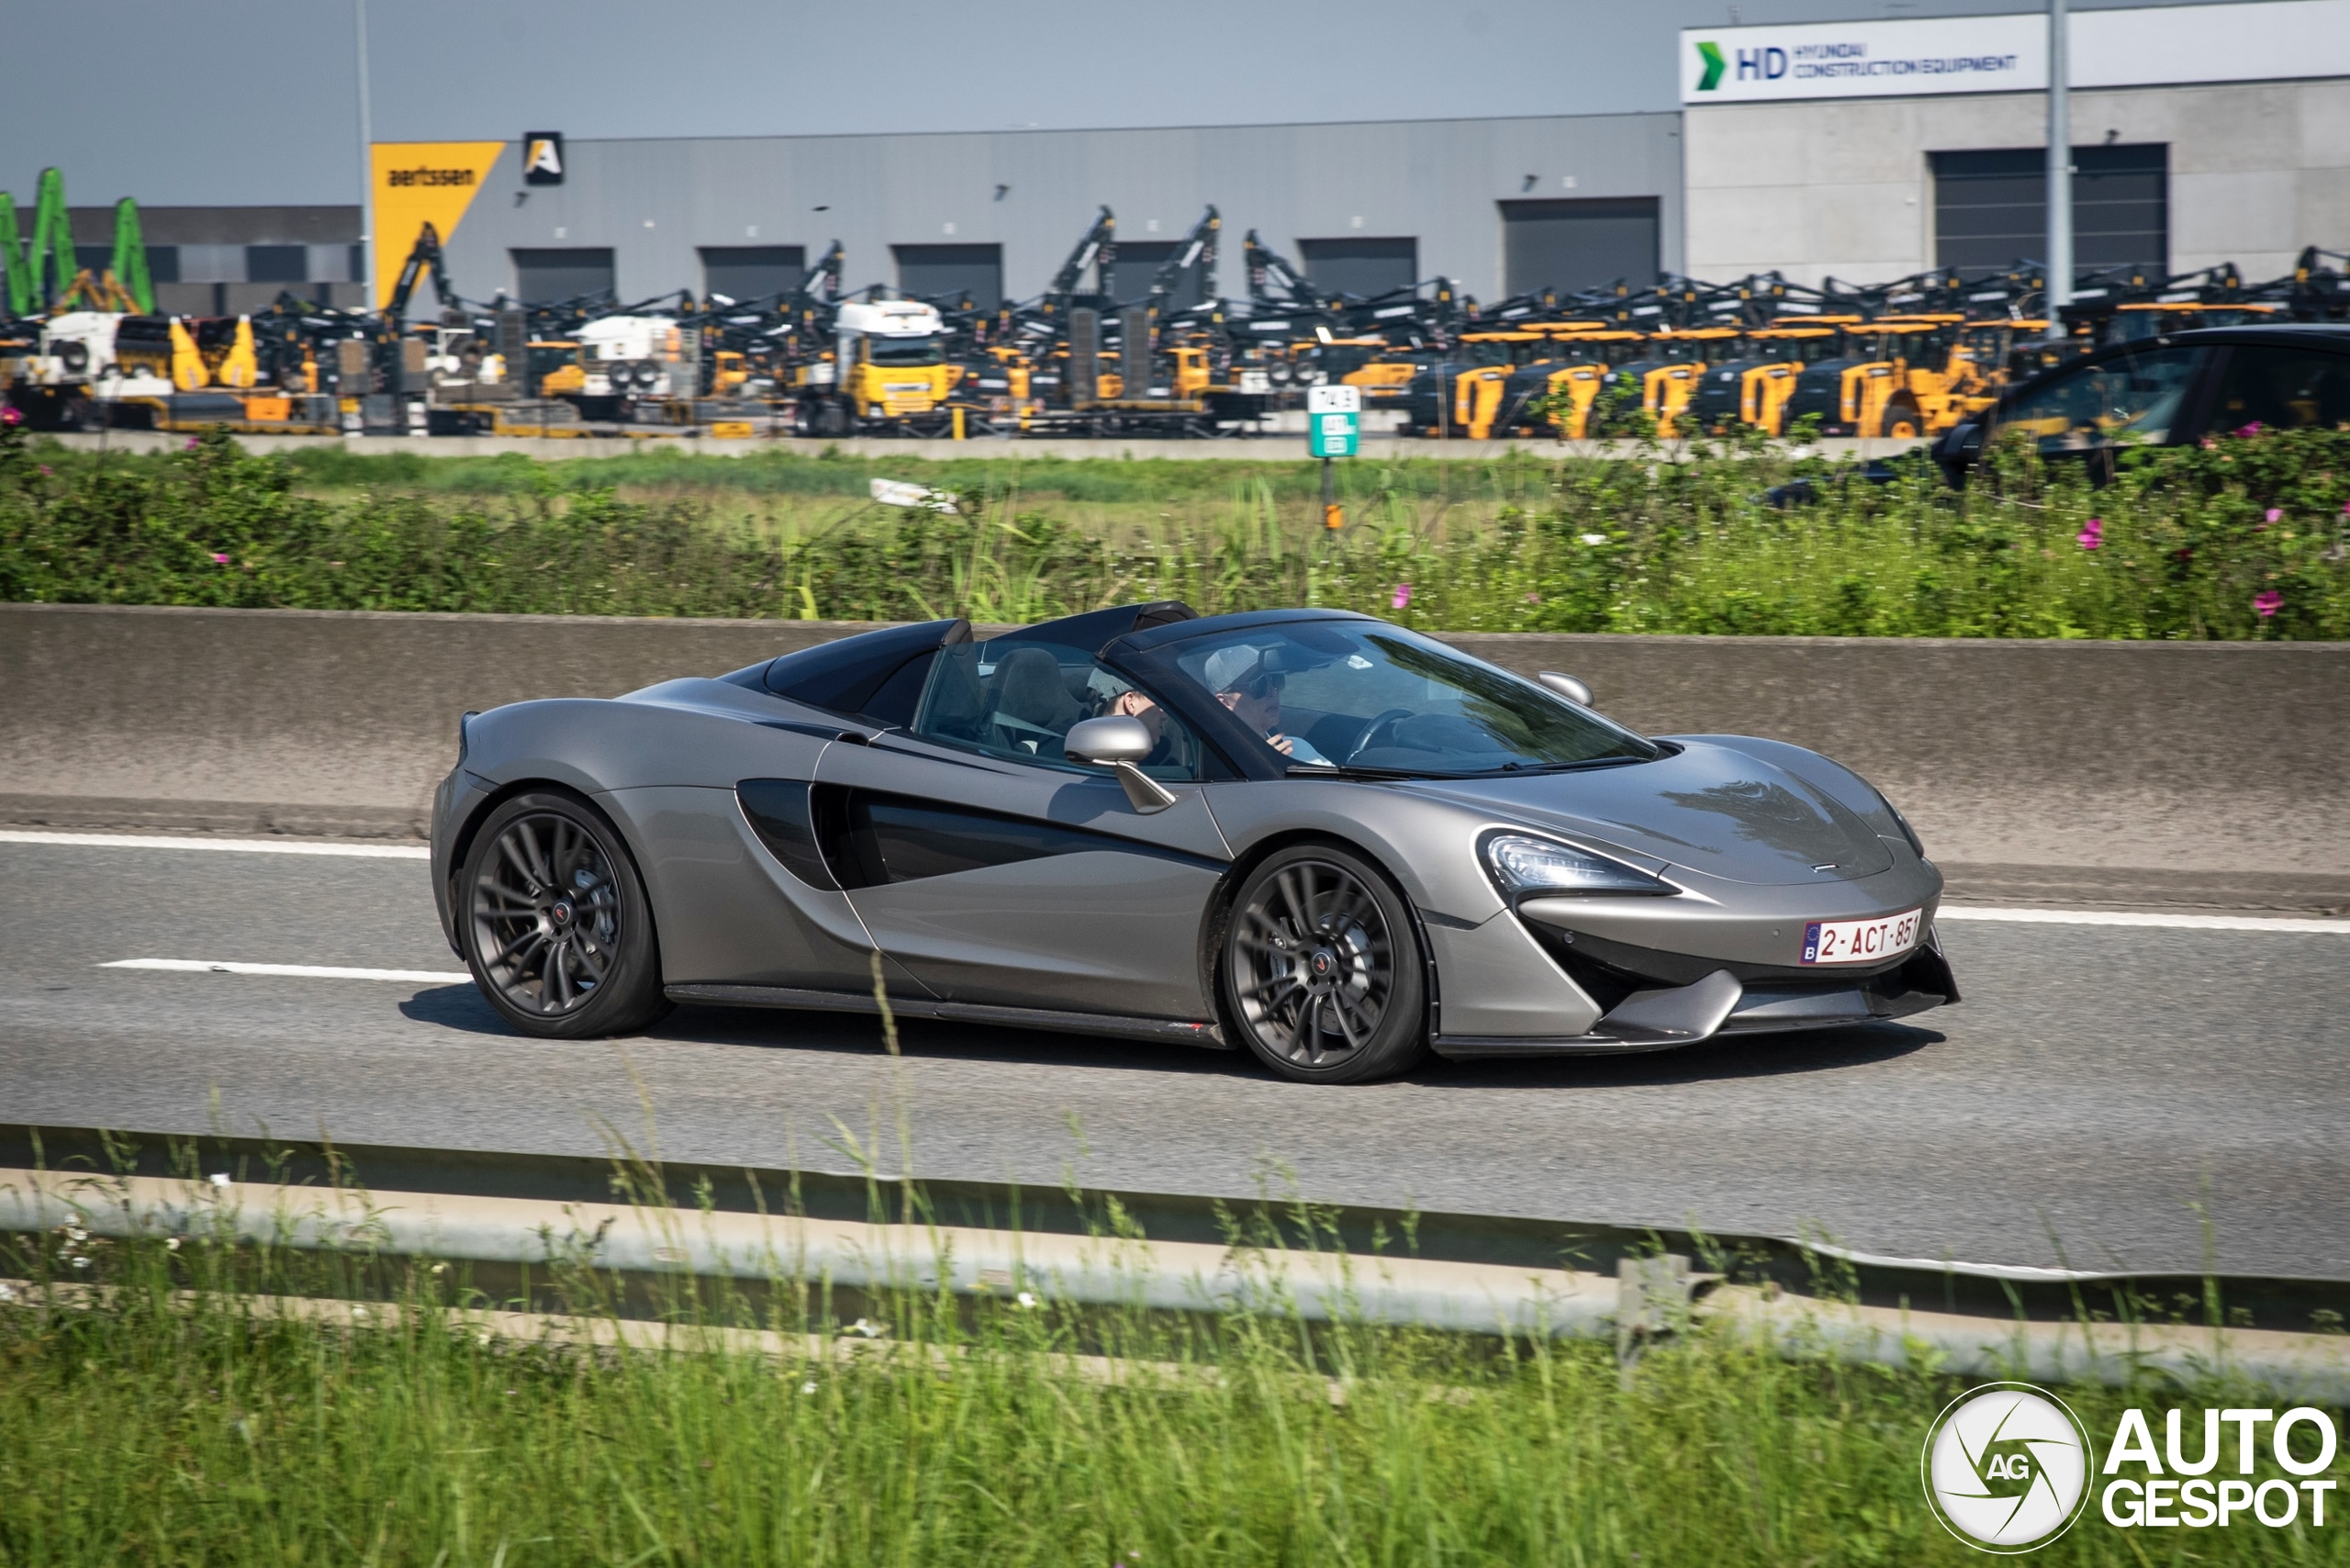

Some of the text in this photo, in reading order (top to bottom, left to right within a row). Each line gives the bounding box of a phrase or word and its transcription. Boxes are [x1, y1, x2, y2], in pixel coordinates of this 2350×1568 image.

[1792, 44, 1867, 59] HYUNDAI
[1736, 47, 1787, 81] HD
[1793, 55, 2016, 78] CONSTRUCTION EQUIPMENT
[389, 166, 474, 186] aertssen
[1821, 915, 1919, 956] 2-ACT-851
[1804, 946, 1816, 960] B
